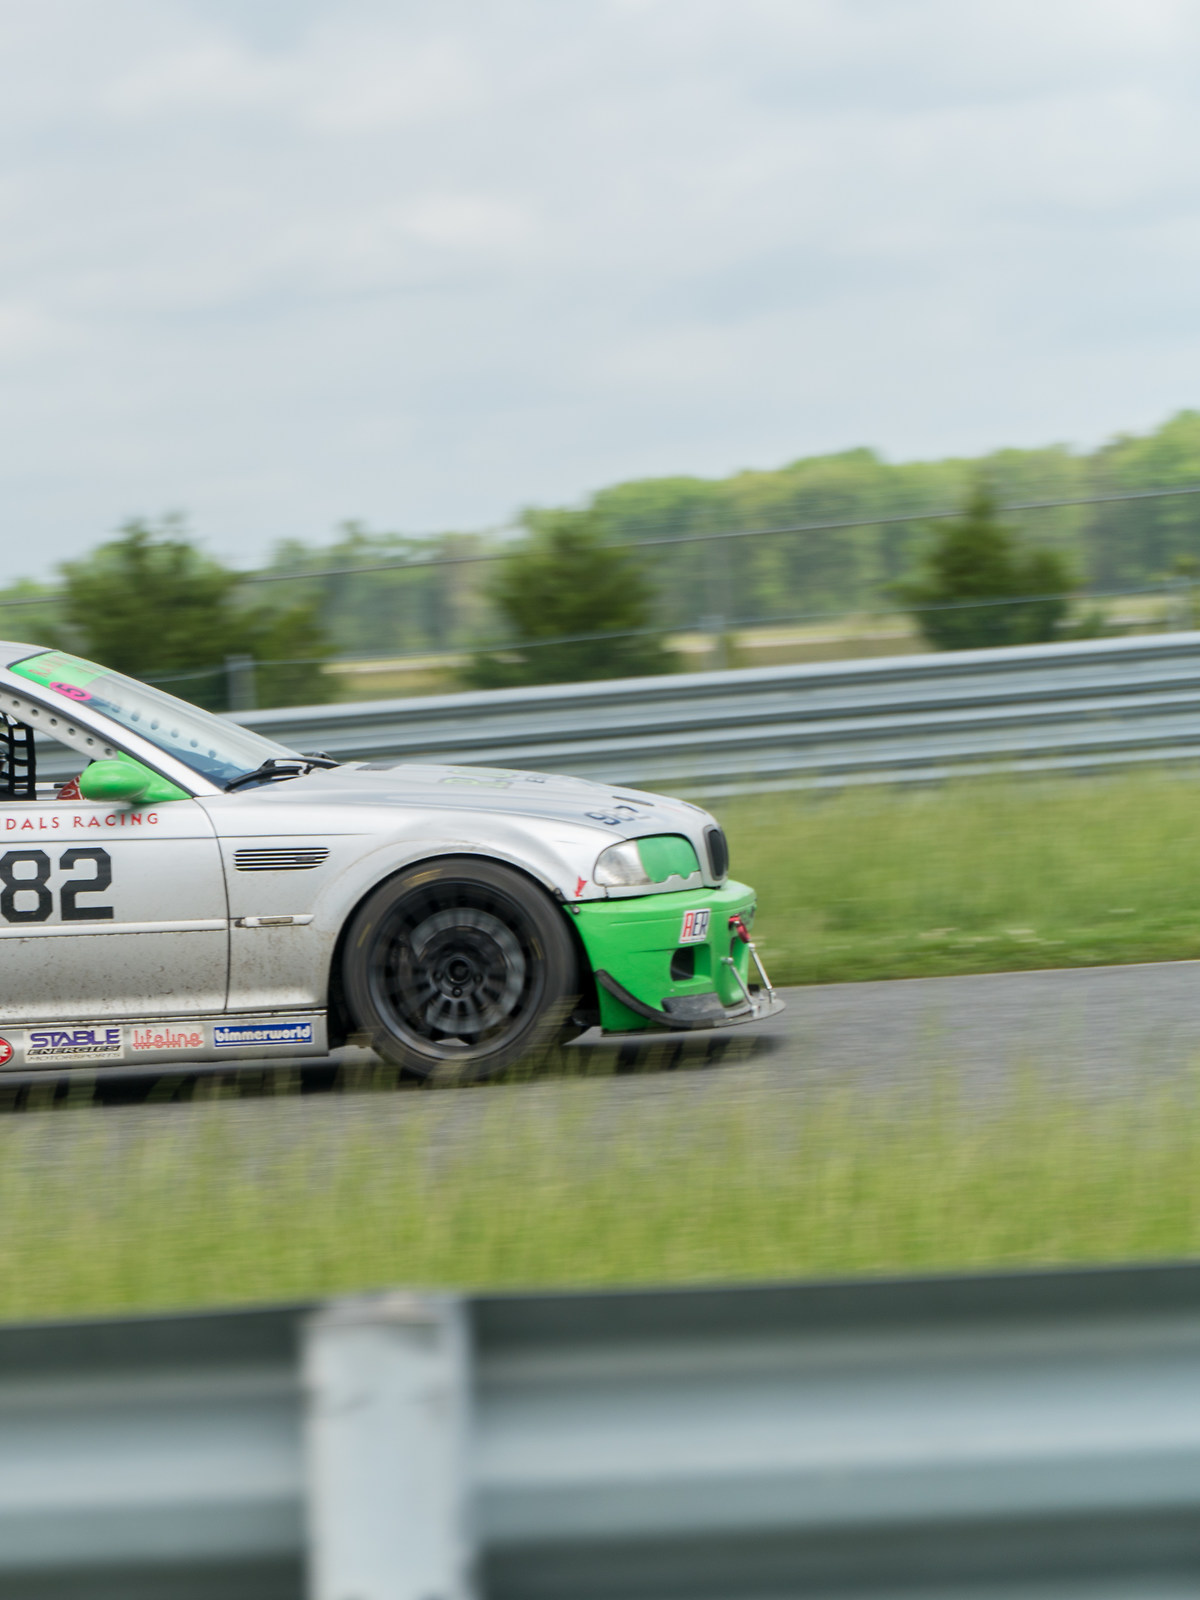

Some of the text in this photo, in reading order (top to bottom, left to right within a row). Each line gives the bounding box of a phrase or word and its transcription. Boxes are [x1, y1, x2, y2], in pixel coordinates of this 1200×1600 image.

[73, 812, 159, 828] RACING
[682, 911, 709, 937] AER
[29, 1028, 121, 1049] STABLE
[133, 1028, 204, 1050] lifeline
[215, 1025, 311, 1042] bimmerworld
